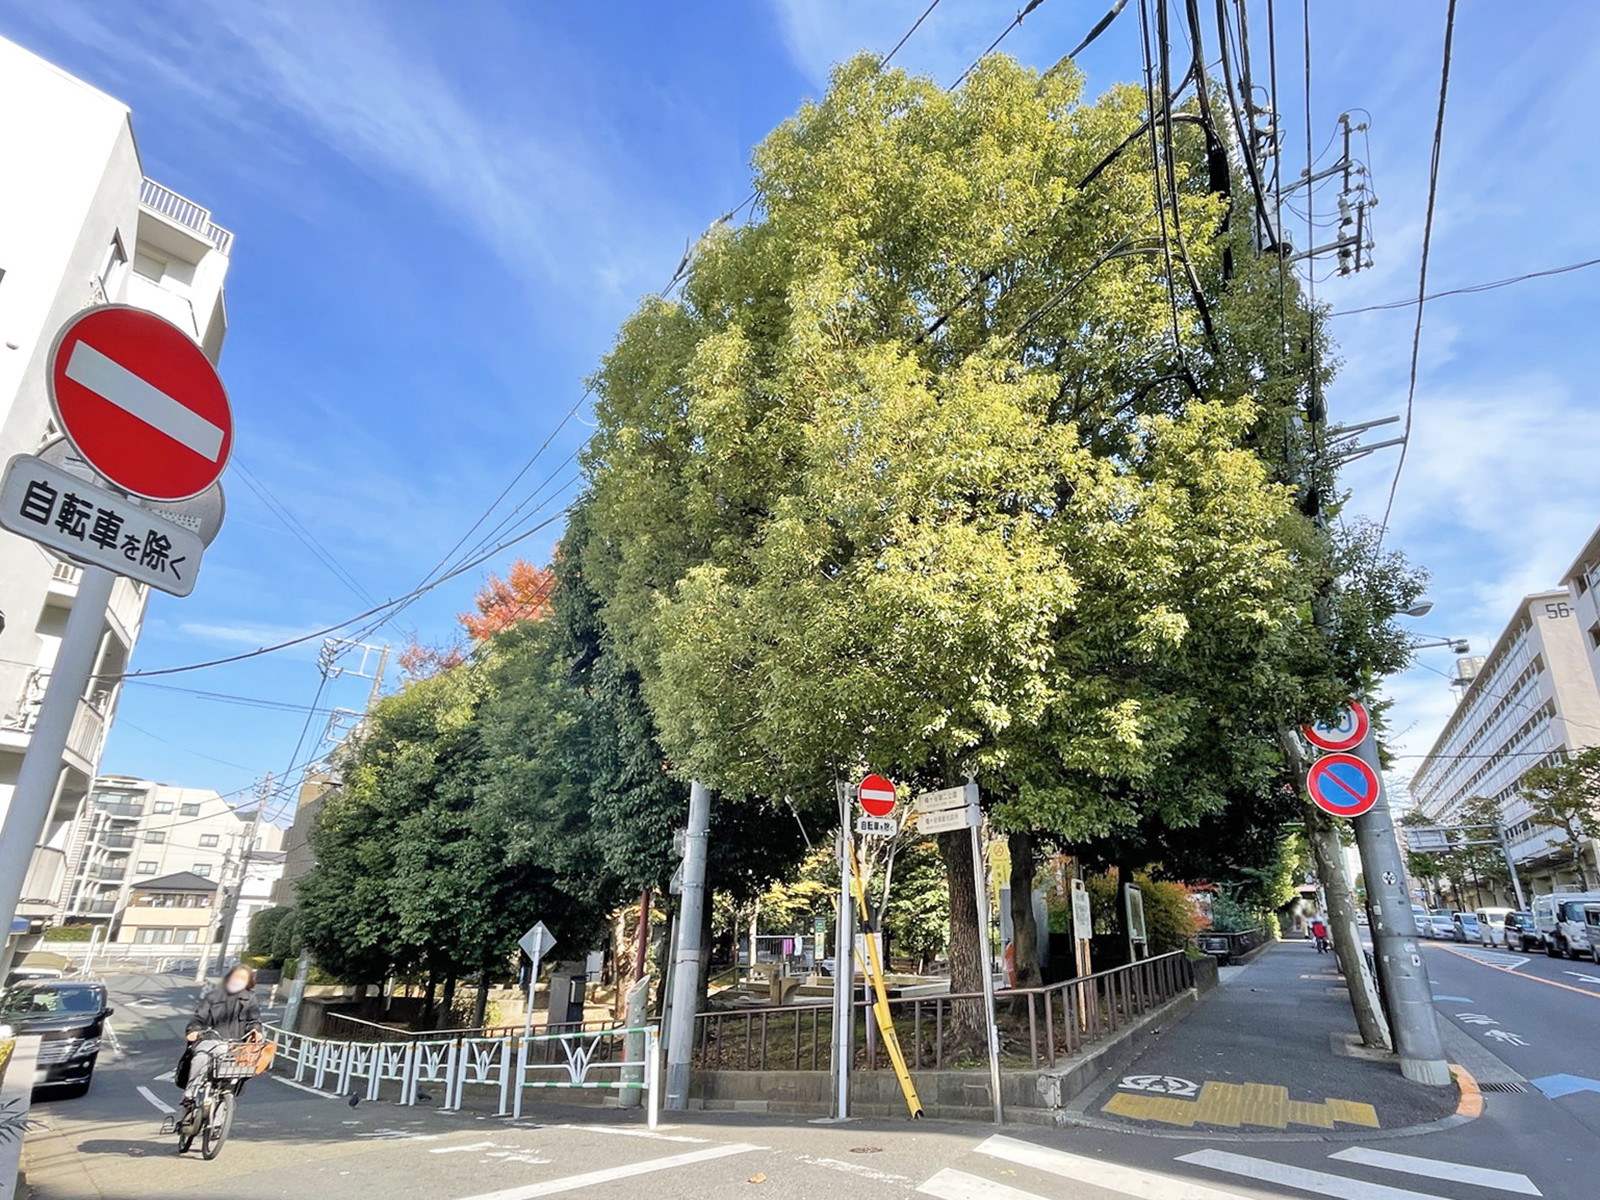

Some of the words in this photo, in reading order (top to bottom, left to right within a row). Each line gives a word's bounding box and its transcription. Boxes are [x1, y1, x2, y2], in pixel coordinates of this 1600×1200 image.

[19, 480, 187, 581] 自転車を除く
